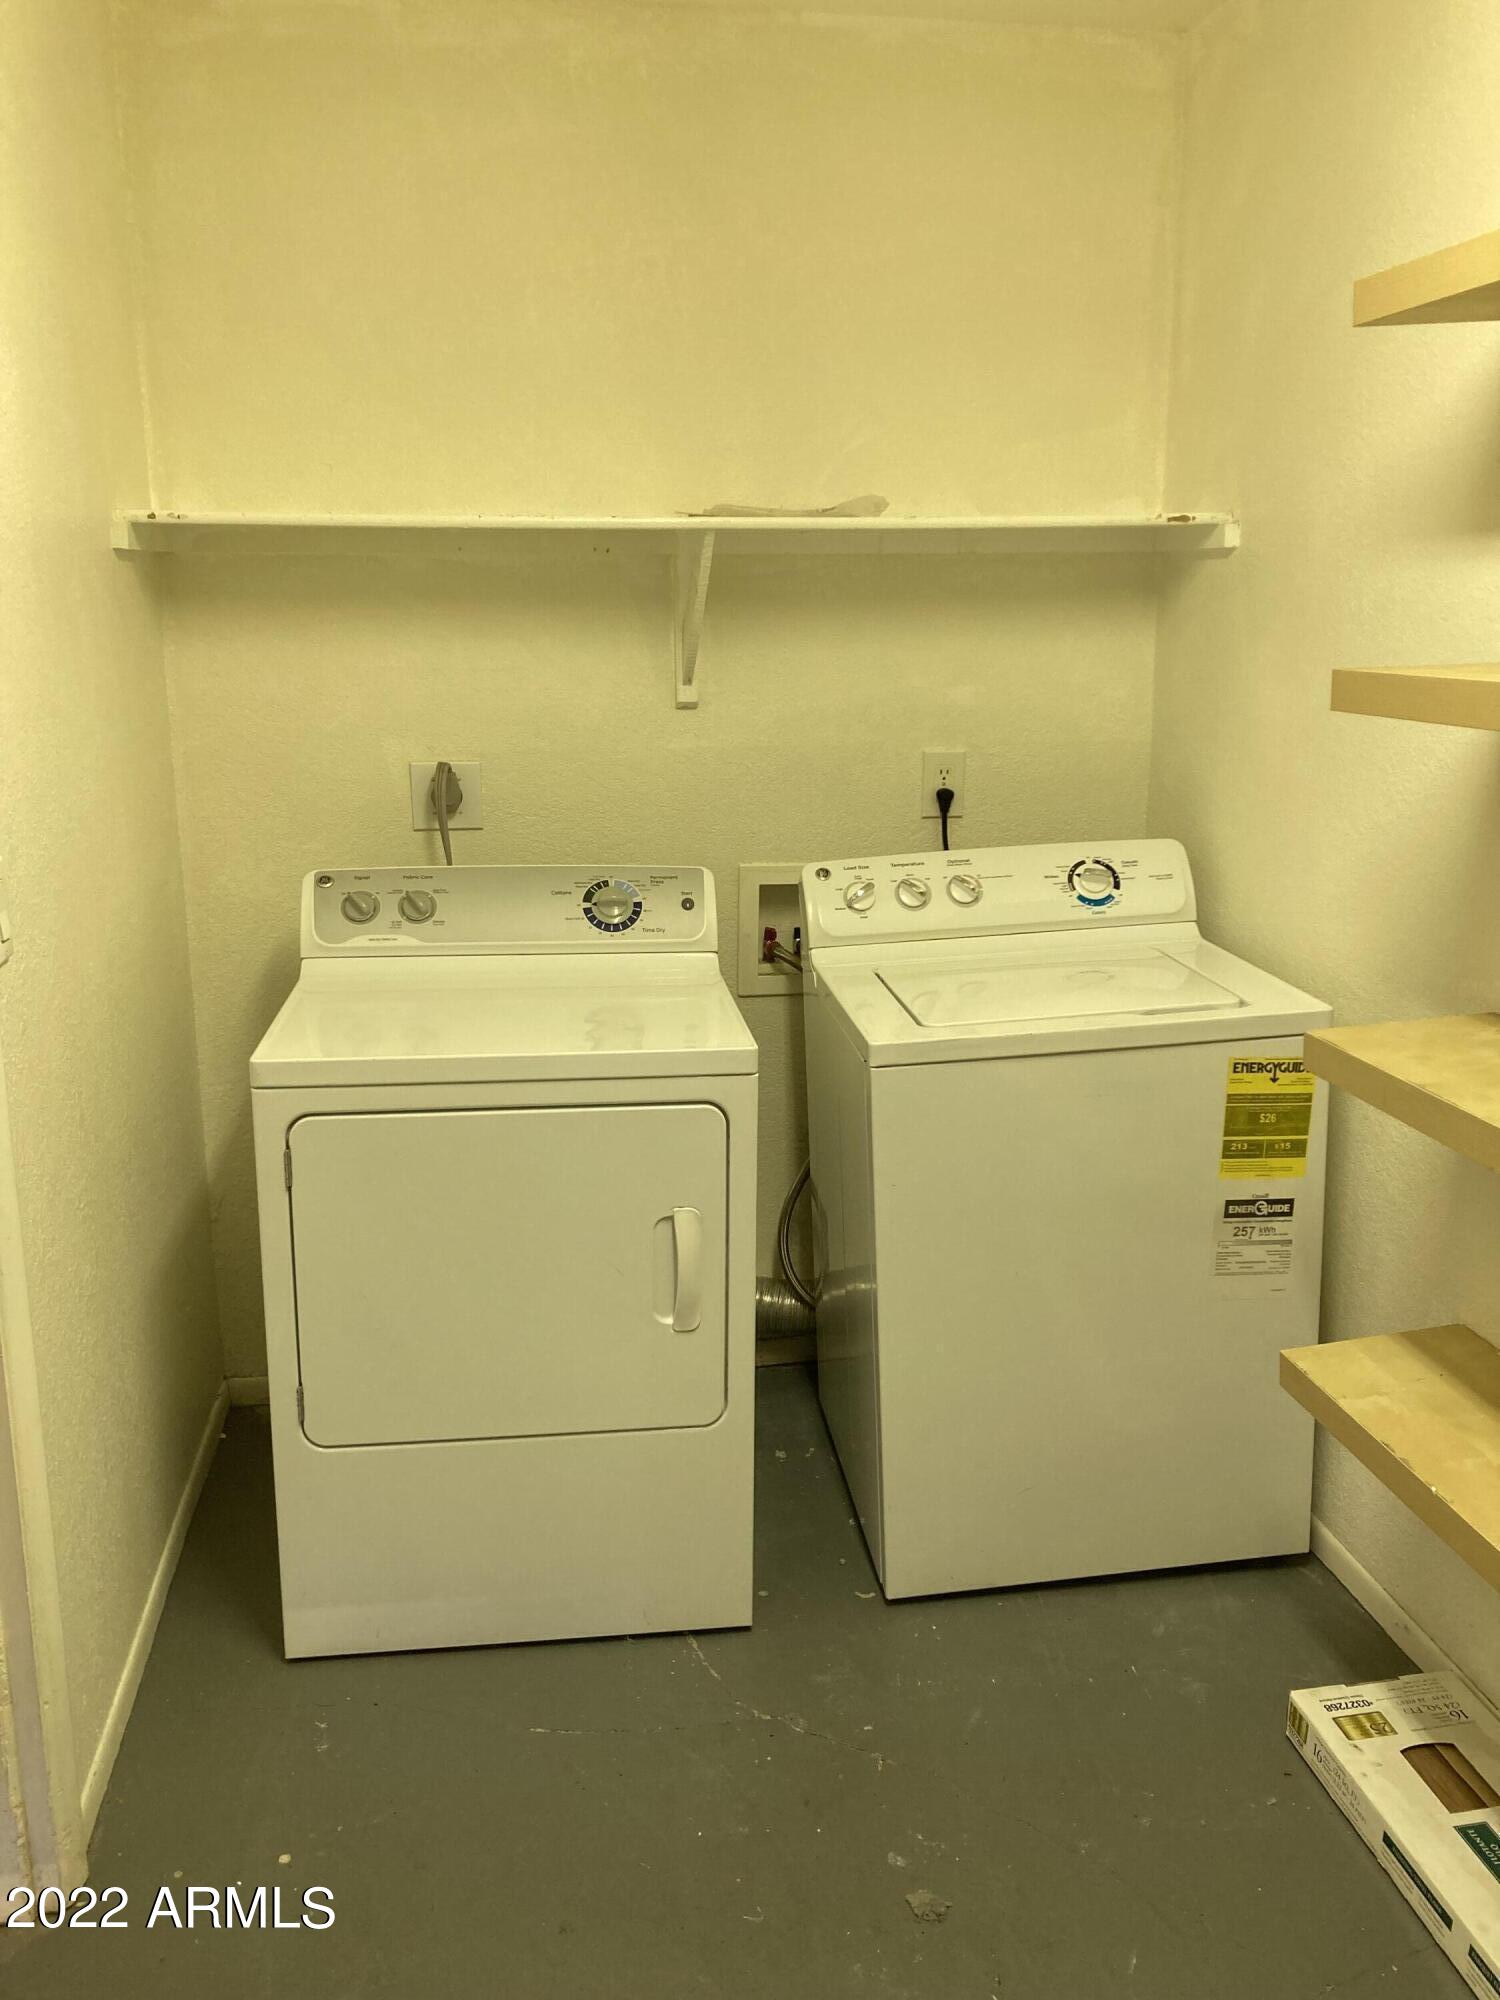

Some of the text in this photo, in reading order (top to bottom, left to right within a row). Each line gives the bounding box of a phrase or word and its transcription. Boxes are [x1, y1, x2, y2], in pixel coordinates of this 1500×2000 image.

[1232, 1061, 1311, 1075] ENERGYGUID
[1258, 1113, 1277, 1123] $26
[1229, 1143, 1248, 1151] 213
[1228, 1201, 1291, 1216] ENERGUIDE
[1233, 1226, 1256, 1239] 257
[1258, 1226, 1277, 1234] kWh
[1449, 1709, 1469, 1721] 16
[1369, 1722, 1393, 1735] 25
